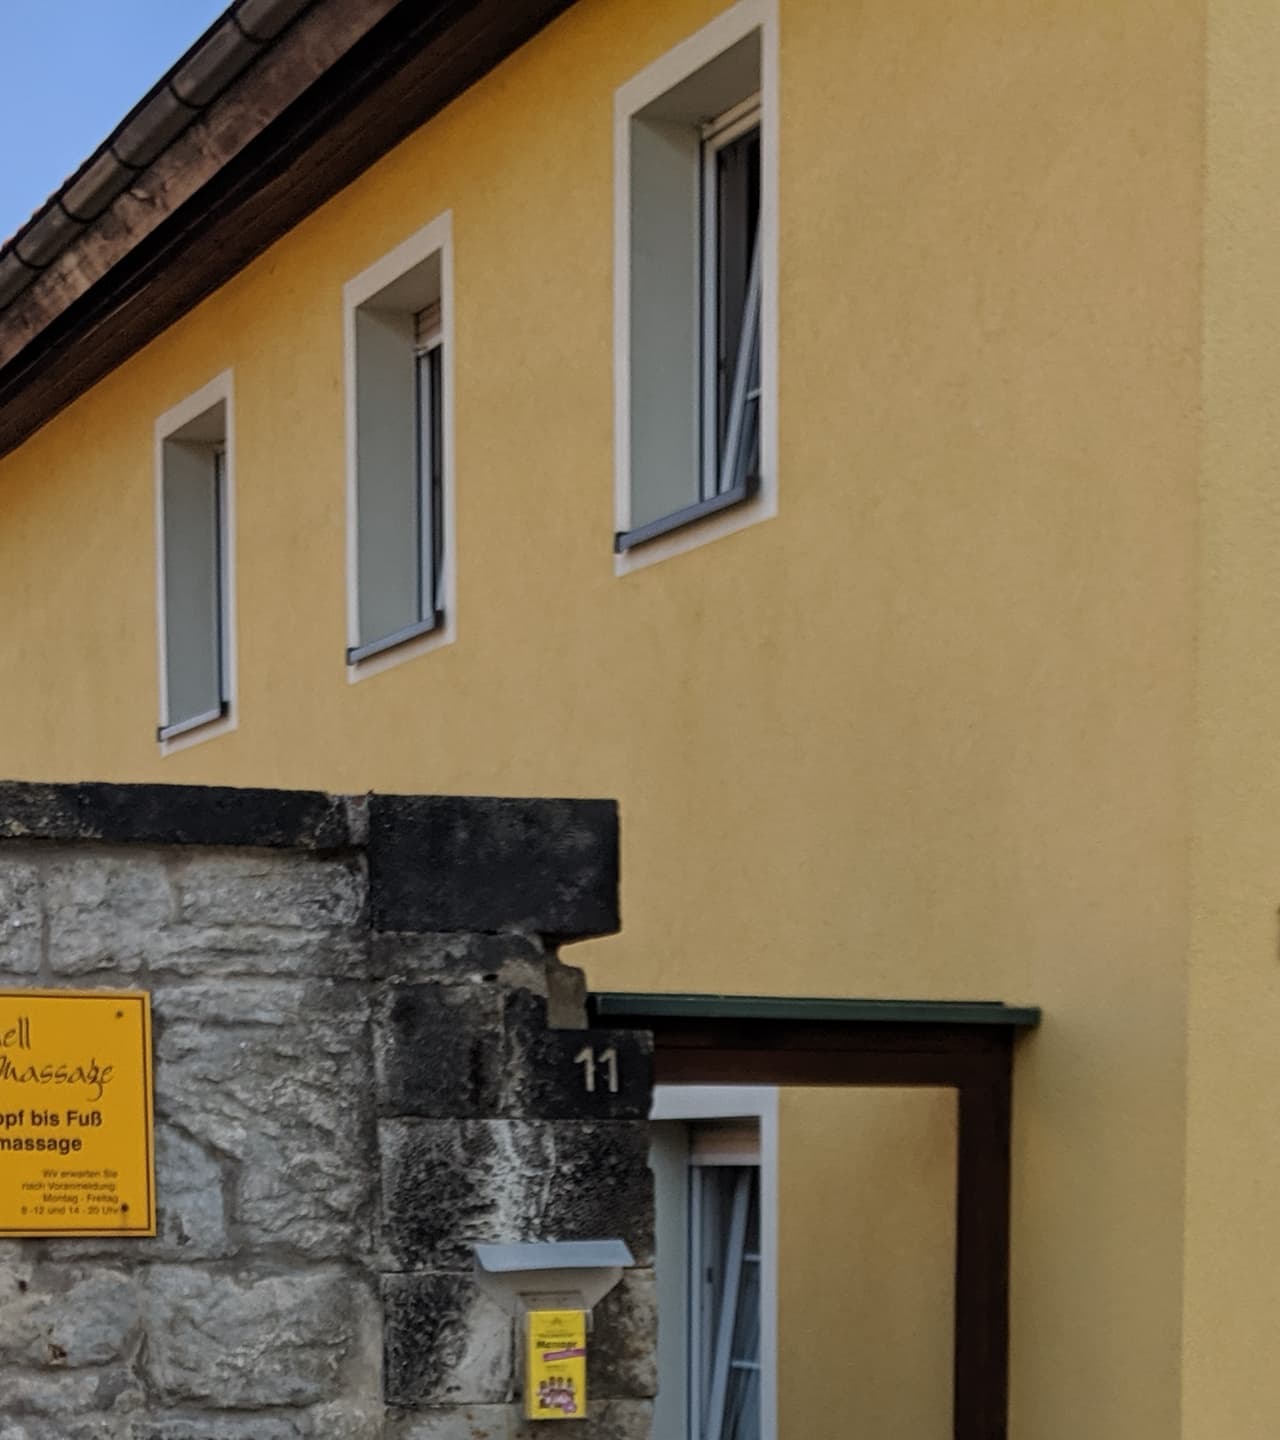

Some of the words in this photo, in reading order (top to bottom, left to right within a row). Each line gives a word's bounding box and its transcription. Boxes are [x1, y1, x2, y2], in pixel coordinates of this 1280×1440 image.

[574, 1045, 619, 1093] 11
[31, 1109, 60, 1127] bis
[66, 1109, 103, 1127] Fuß
[43, 1193, 79, 1204] Montag
[86, 1193, 119, 1204] Freitag
